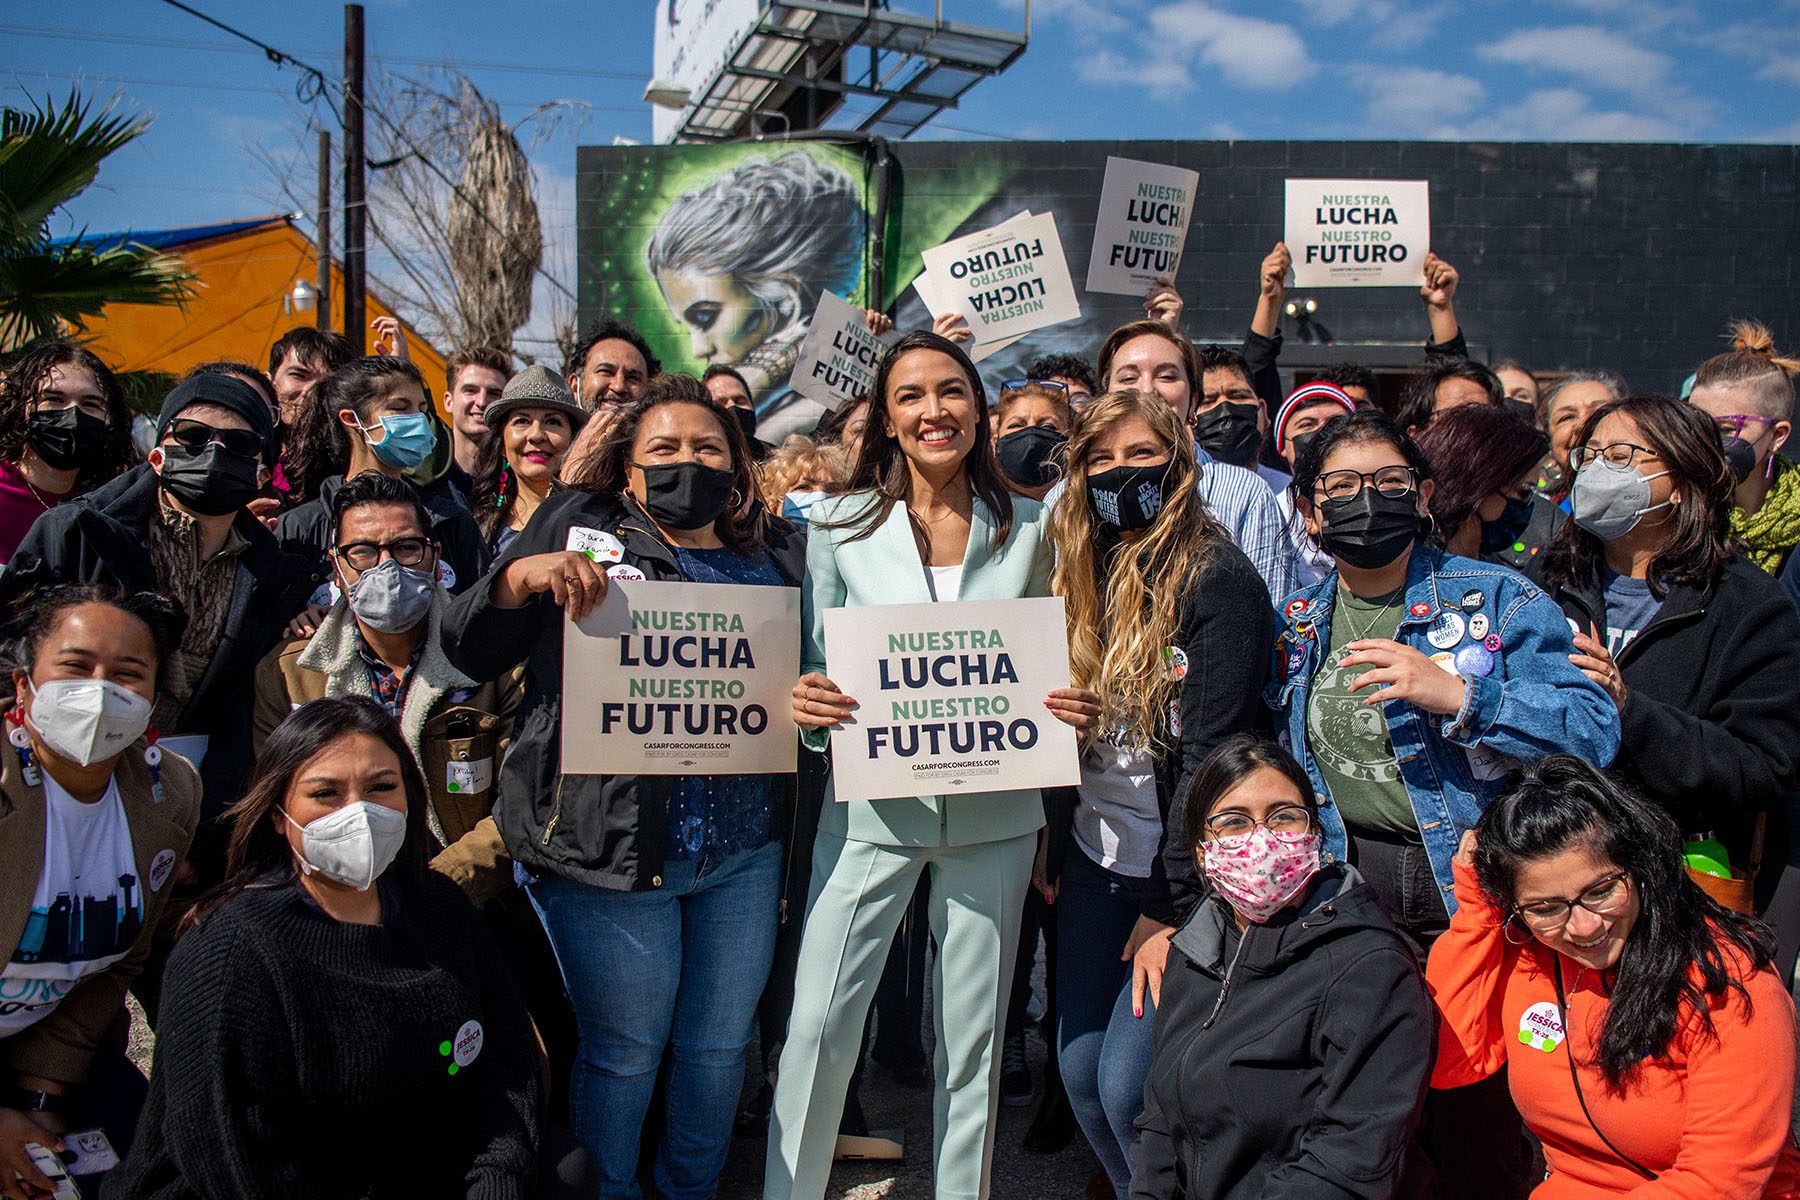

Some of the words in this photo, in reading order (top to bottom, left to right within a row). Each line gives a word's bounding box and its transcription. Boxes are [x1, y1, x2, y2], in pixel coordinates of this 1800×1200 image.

[1322, 195, 1391, 206] NUESTRA
[1315, 208, 1398, 225] LUCHA
[1321, 231, 1392, 242] NUESTRO
[950, 238, 1044, 279] FUTURO
[1305, 244, 1408, 264] FUTURO
[969, 262, 1035, 288] NUESTRO
[968, 277, 1046, 313] LUCHA
[981, 299, 1044, 325] NUESTRA
[832, 330, 883, 369] LUCH
[844, 321, 889, 353] NUESTR
[811, 360, 870, 399] FUTU
[831, 354, 876, 384] NUESTR
[1137, 480, 1152, 493] IT'S
[1137, 484, 1159, 504] ABOUT
[1139, 493, 1163, 521] US
[631, 610, 745, 633] NUESTRA
[1433, 614, 1453, 628] ELECT
[1434, 621, 1456, 635] TEXAS
[888, 629, 1005, 654] NUESTRA
[1433, 628, 1460, 643] WOMEN
[619, 634, 756, 669] LUCHA
[878, 652, 1019, 691] LUCHA
[628, 678, 746, 700] NUESTRO
[601, 703, 769, 736] FUTURO
[891, 694, 1010, 721] NUESTRO
[643, 742, 731, 750] CASARFORCONGRESS.COM
[866, 718, 1039, 759] FUTURO
[911, 759, 1000, 771] CASARFORCONGRESS.COM
[1526, 1011, 1565, 1034] JESSICA
[456, 1028, 481, 1054] JESSICA
